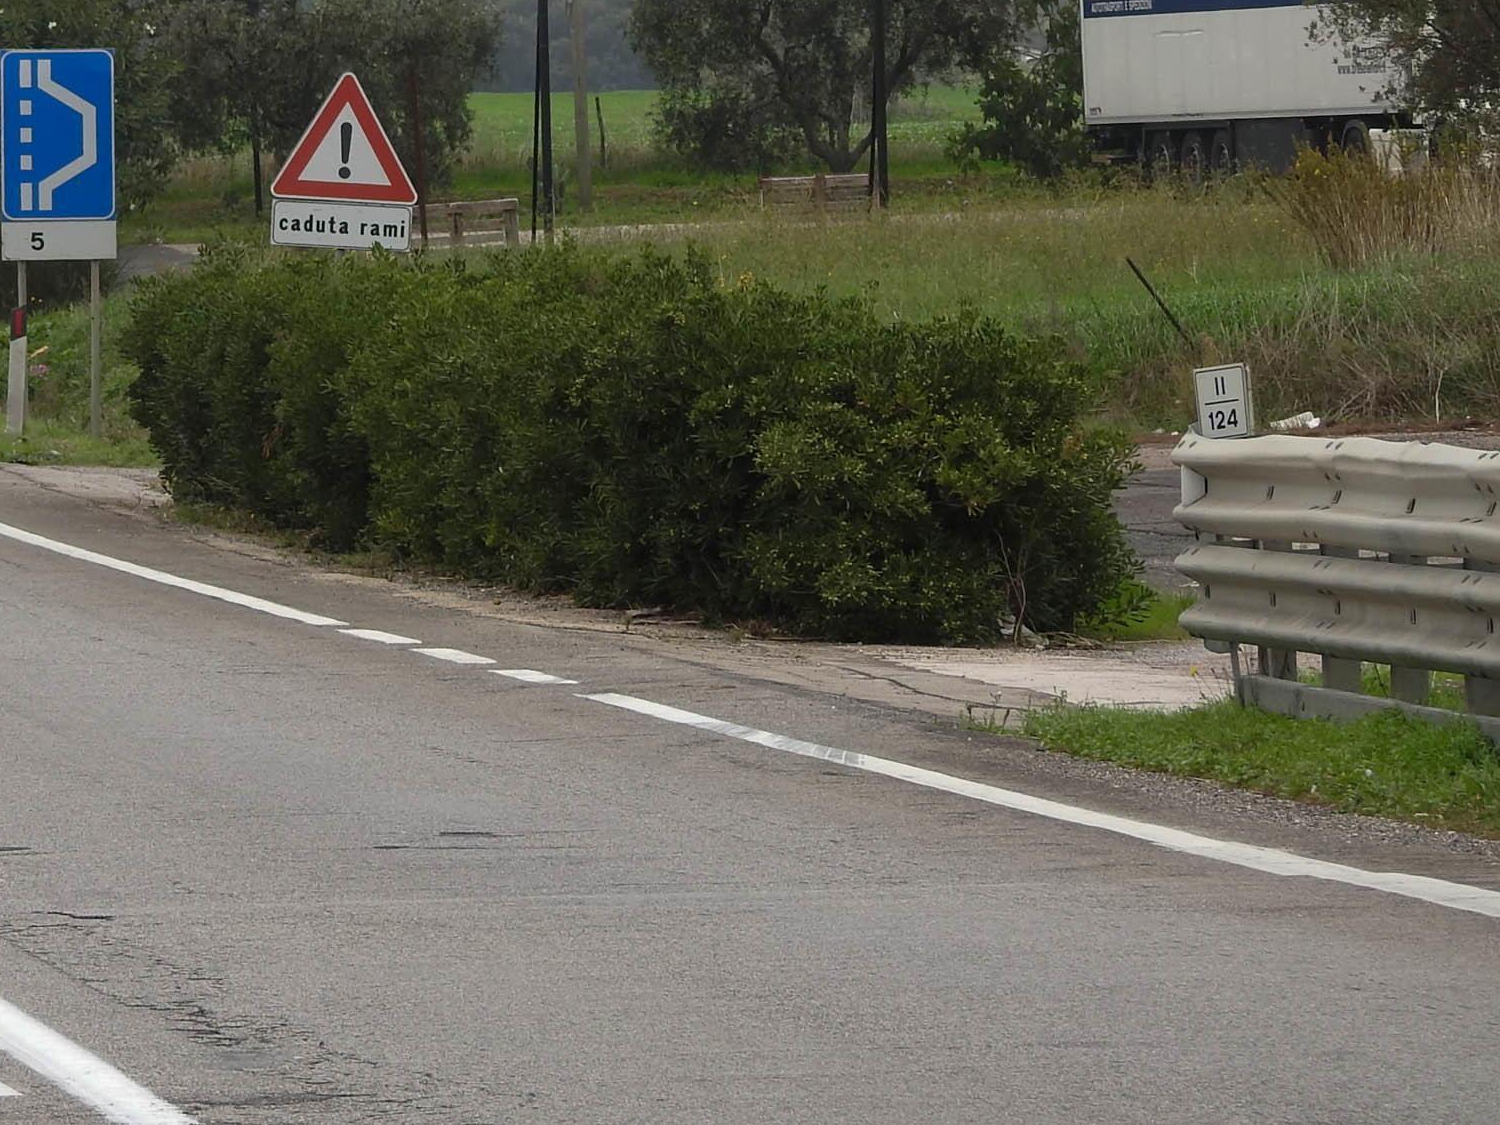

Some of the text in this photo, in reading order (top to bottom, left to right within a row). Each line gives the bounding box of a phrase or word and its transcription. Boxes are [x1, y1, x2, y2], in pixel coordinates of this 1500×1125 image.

[277, 214, 405, 238] caduta rami
[31, 232, 44, 250] 5
[1208, 408, 1239, 431] 124
